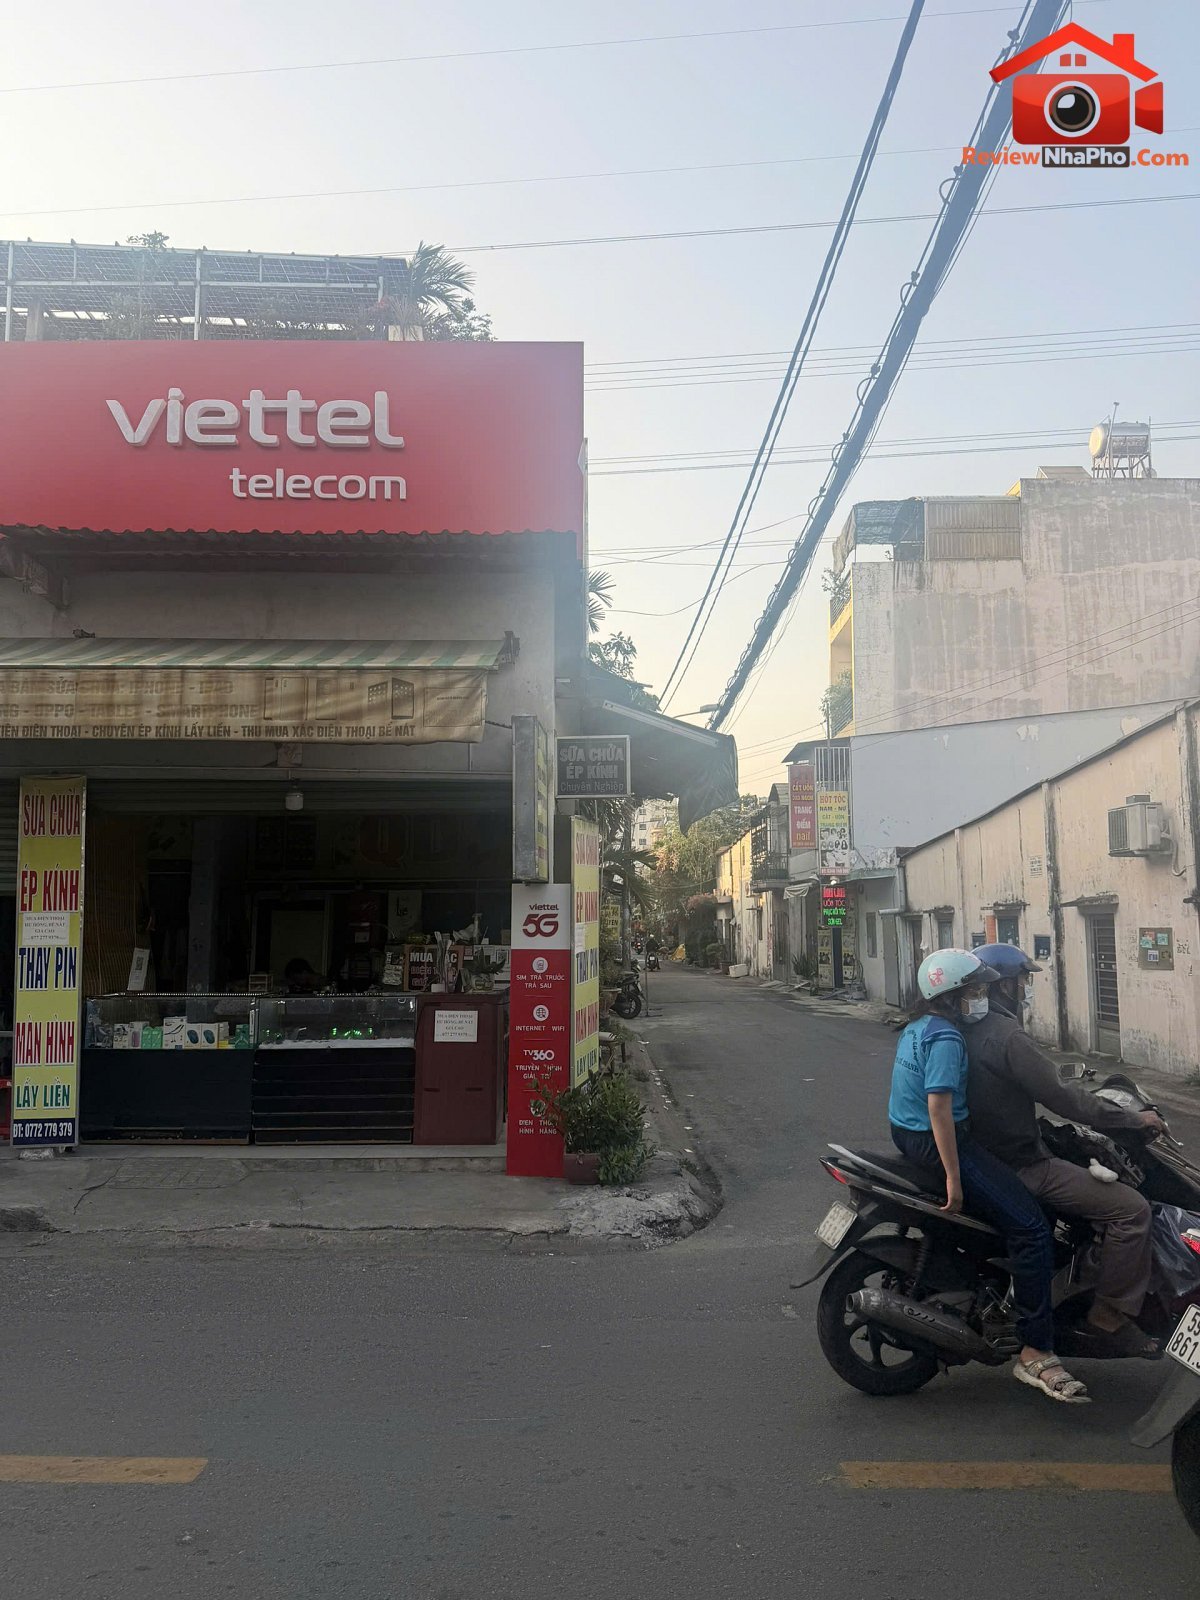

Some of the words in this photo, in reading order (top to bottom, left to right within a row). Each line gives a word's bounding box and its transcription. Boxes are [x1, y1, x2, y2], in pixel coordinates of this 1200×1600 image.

[106, 388, 404, 448] viettel
[229, 468, 406, 500] telecom
[92, 724, 134, 737] CHUYÊN
[155, 723, 181, 737] KÍNH
[242, 726, 261, 737] THU
[265, 726, 289, 737] MUA
[292, 724, 314, 737] XÁC
[566, 762, 583, 779] ÉP
[587, 762, 618, 778] KÍNH
[21, 864, 37, 911] ÉP
[43, 864, 79, 911] KÍNH
[522, 914, 559, 937] 5G
[19, 947, 49, 989] THAY
[54, 947, 77, 989] PIN
[410, 952, 433, 962] MUA
[16, 1014, 42, 1064] MÀN
[46, 1014, 75, 1064] HÌNH
[523, 1049, 554, 1060] TV360
[17, 1077, 39, 1108] LẤY
[44, 1077, 70, 1107] LIỀN
[25, 1123, 42, 1138] 0772
[44, 1122, 57, 1137] 779
[58, 1122, 72, 1137] 379
